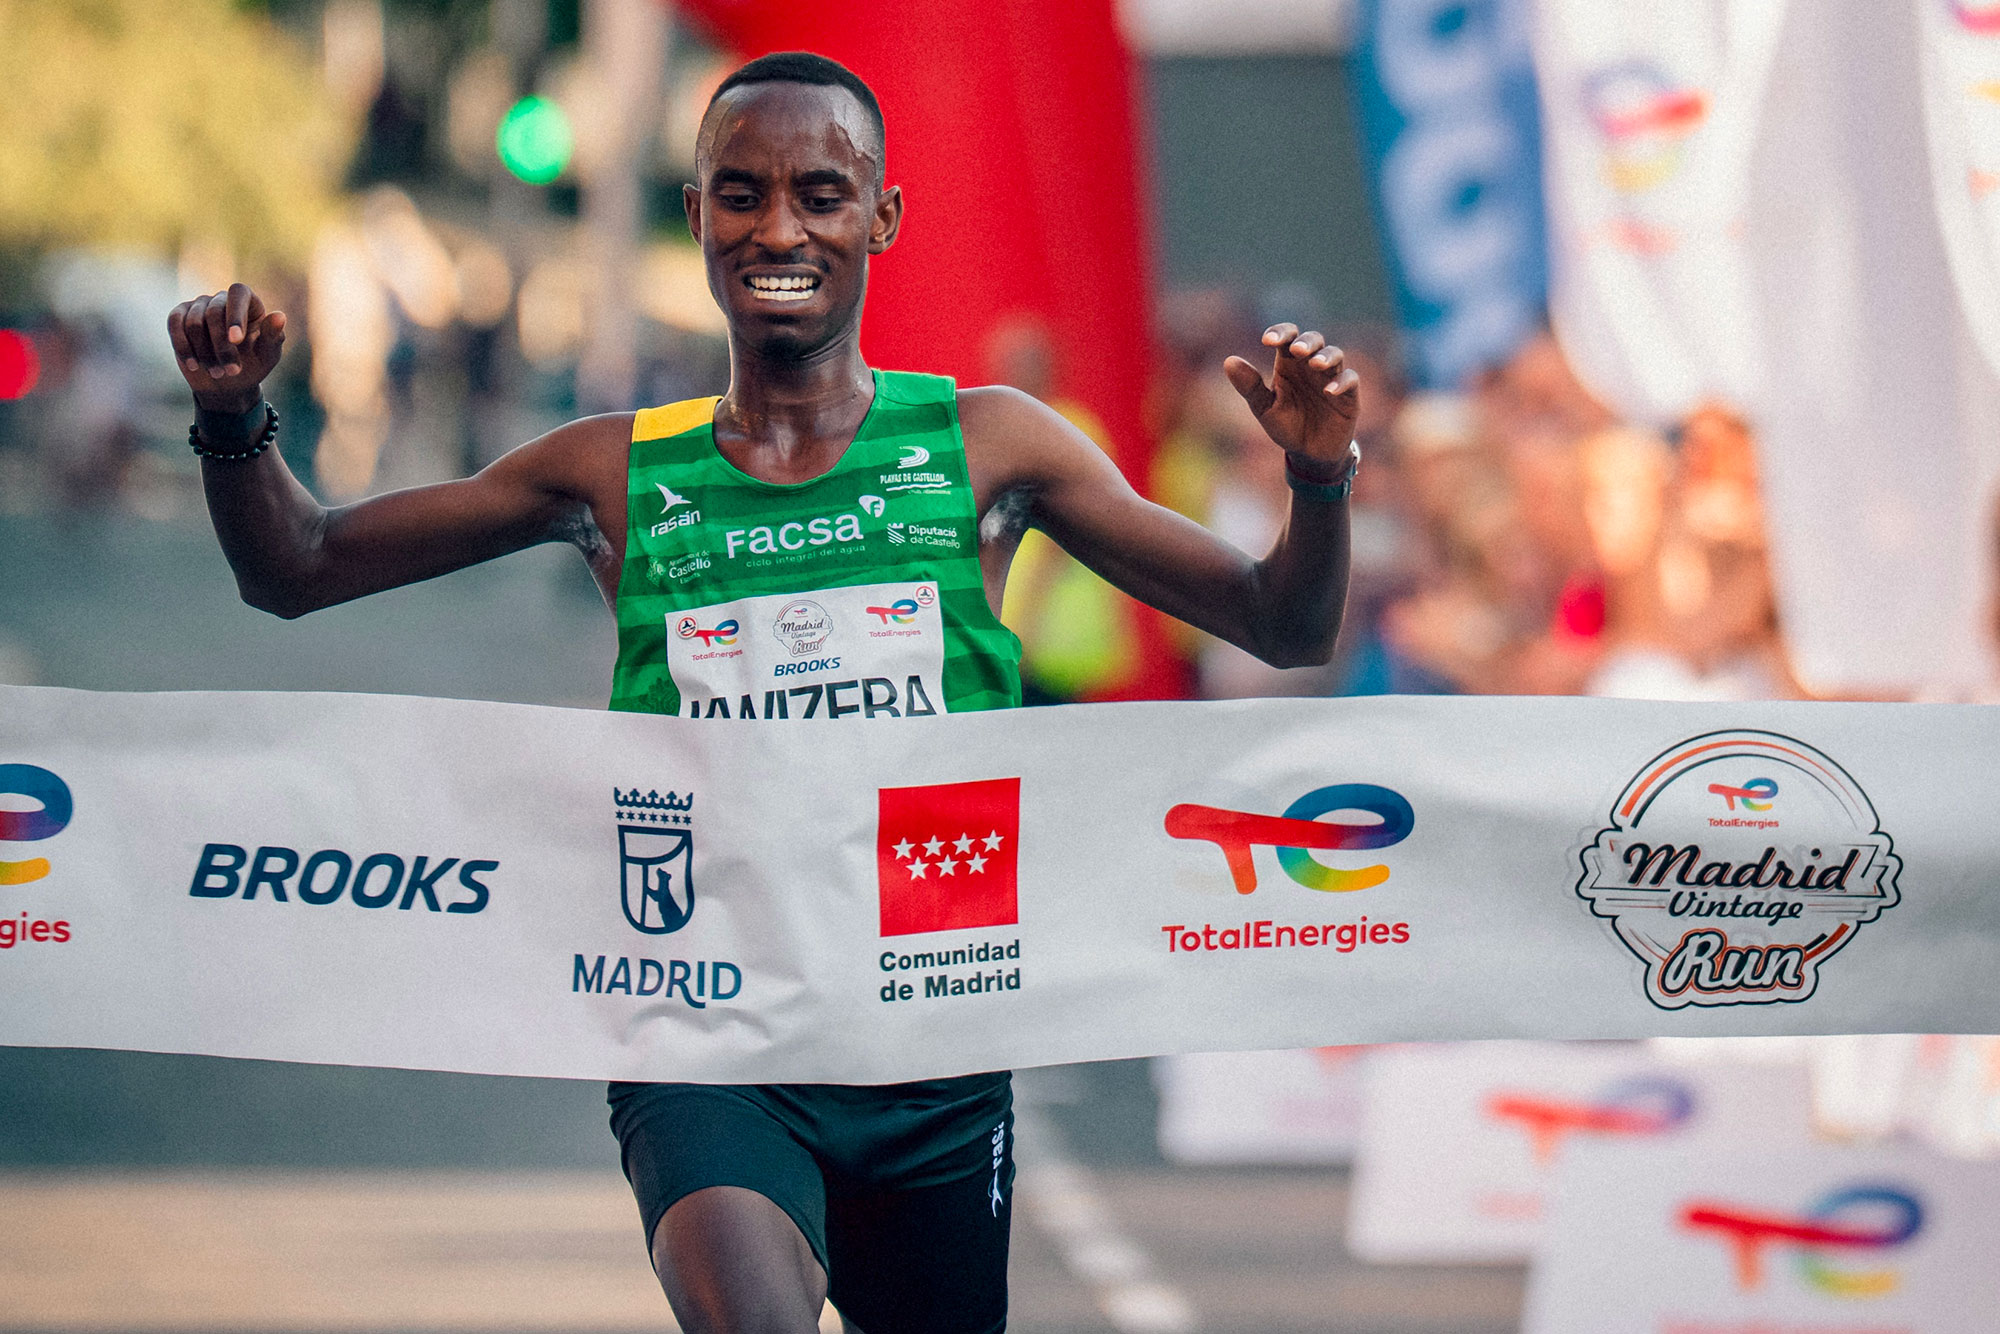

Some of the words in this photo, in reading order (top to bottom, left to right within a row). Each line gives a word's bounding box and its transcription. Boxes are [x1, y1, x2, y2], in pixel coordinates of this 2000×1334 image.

[726, 514, 865, 560] Facsa
[908, 525, 957, 538] Diputació
[910, 536, 924, 545] de
[668, 556, 711, 579] Castelló
[746, 559, 772, 568] ciclo
[775, 552, 816, 565] integral
[819, 548, 836, 557] del
[840, 545, 866, 555] agua
[780, 618, 824, 633] Madrid
[869, 630, 922, 638] TotalEnergies
[692, 649, 743, 661] TotalEnergies
[774, 657, 841, 677] BROOKS
[1707, 818, 1779, 830] TotalEnergies
[190, 842, 499, 914] BROOKS
[1622, 843, 1861, 892] Madrid
[1669, 891, 1804, 926] Vintage
[1162, 916, 1411, 953] TotalEnergies
[879, 939, 1021, 972] Comunidad
[1659, 929, 1806, 996] Run
[572, 953, 743, 1009] MADRID
[880, 980, 914, 1003] de
[925, 967, 1021, 998] Madrid
